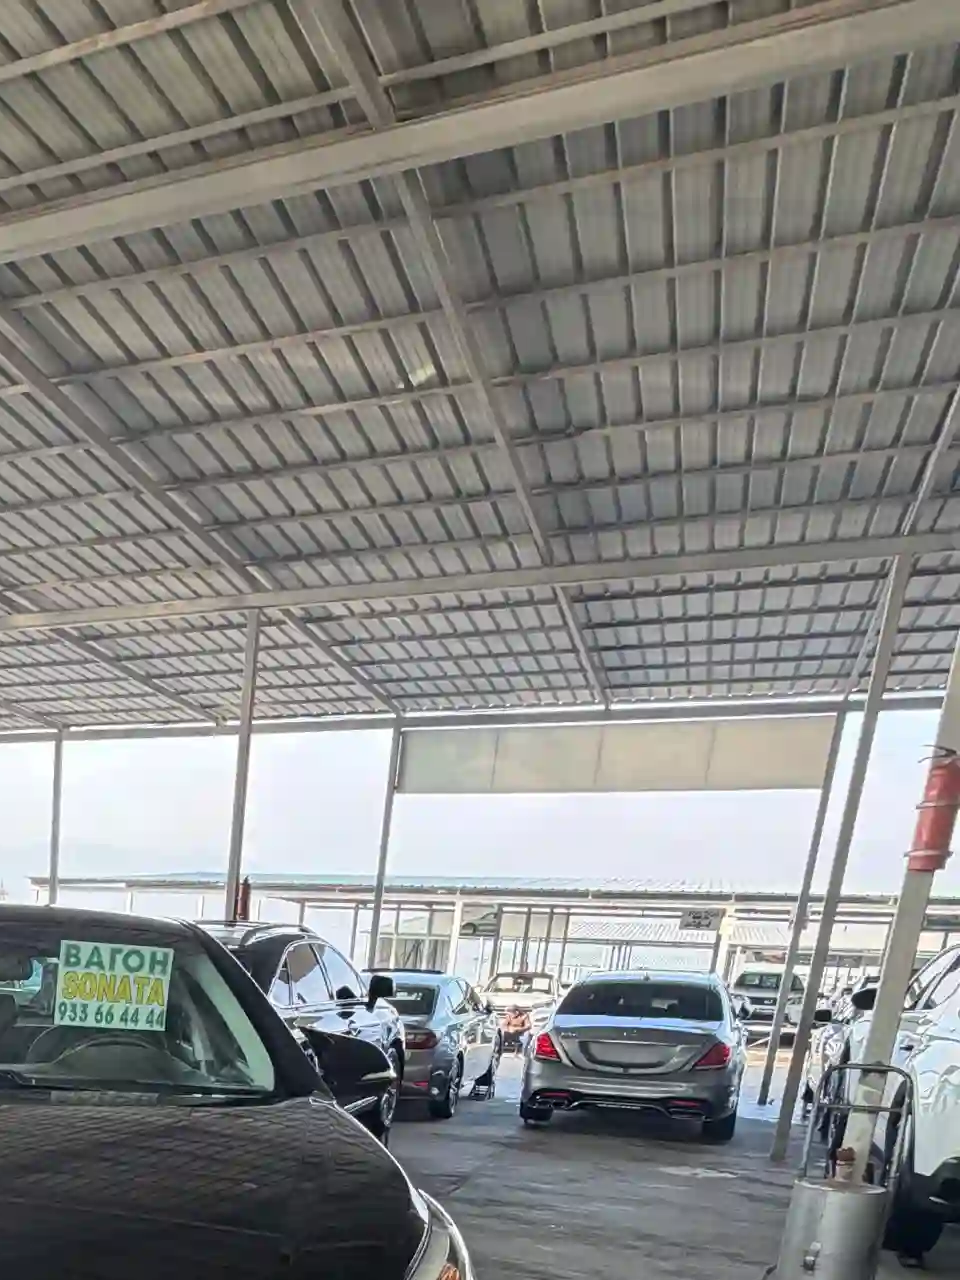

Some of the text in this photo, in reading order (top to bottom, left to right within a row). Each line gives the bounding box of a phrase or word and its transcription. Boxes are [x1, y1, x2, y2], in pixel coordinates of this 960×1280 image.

[63, 944, 169, 977] ВАГОН
[61, 971, 165, 1007] SONATA
[58, 1002, 164, 1028] 933 66 44 44
